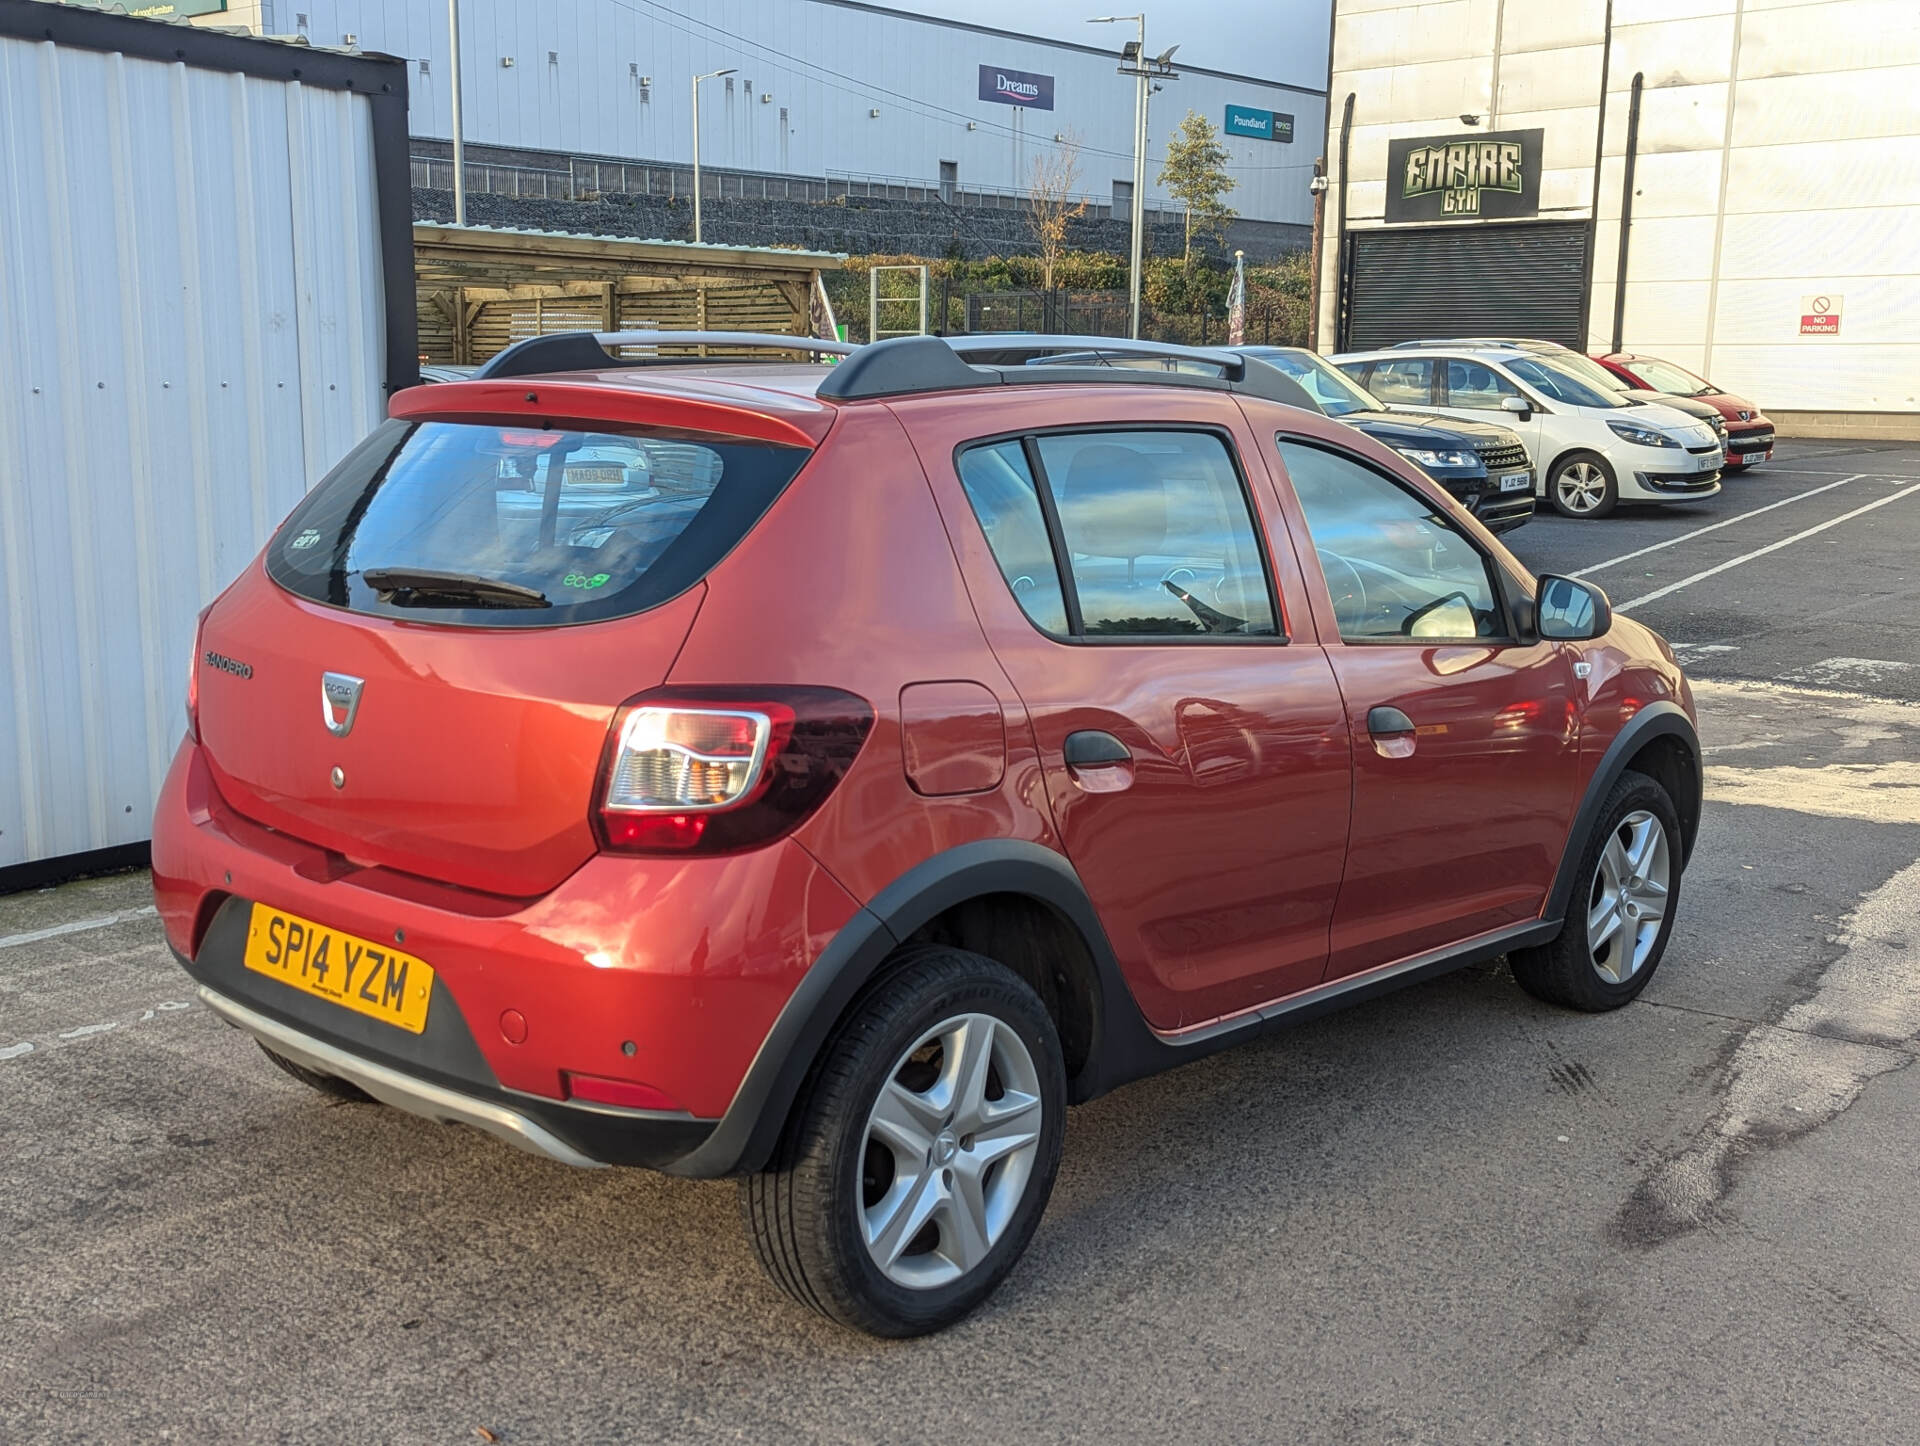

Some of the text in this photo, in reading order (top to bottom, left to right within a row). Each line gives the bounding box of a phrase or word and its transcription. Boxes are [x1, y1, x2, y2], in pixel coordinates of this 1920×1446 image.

[996, 74, 1038, 96] Dreams
[1233, 115, 1266, 129] Poundland
[1406, 143, 1520, 195] EMPIRE
[1442, 189, 1477, 212] GYM
[1813, 316, 1826, 324] NO
[205, 651, 253, 680] SANDERO
[265, 915, 409, 1012] SP14 YZM
